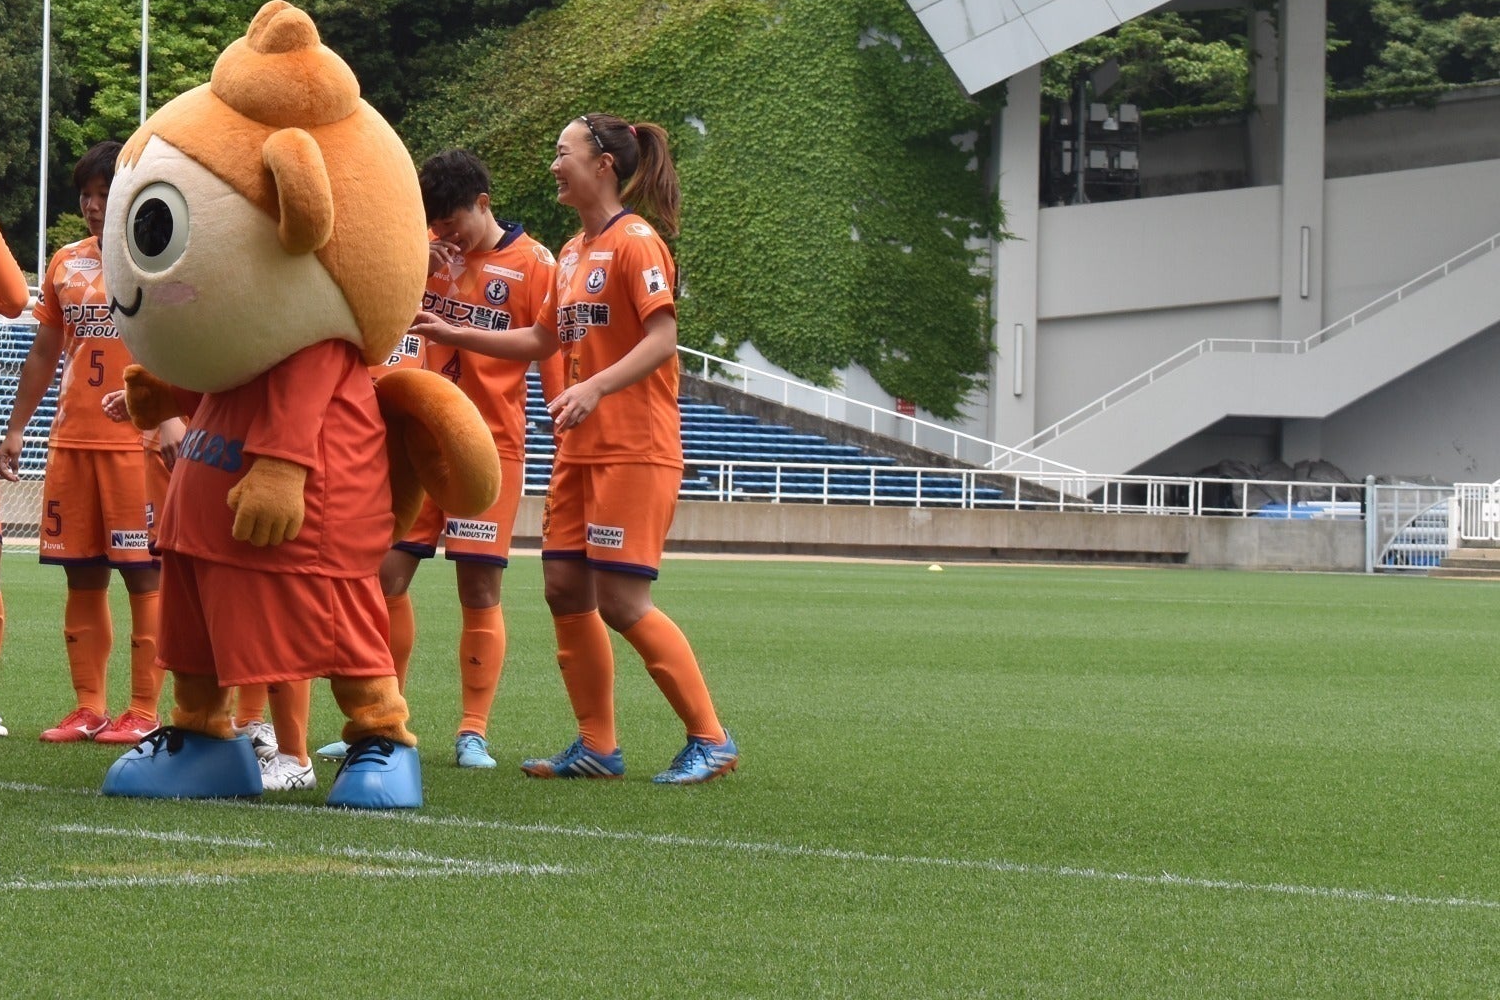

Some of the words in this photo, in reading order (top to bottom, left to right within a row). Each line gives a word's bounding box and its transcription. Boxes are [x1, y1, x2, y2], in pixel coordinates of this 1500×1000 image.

[88, 350, 105, 387] 5
[45, 500, 62, 537] 5
[459, 522, 496, 532] NARAZAKI
[458, 530, 496, 540] INDUSTRY
